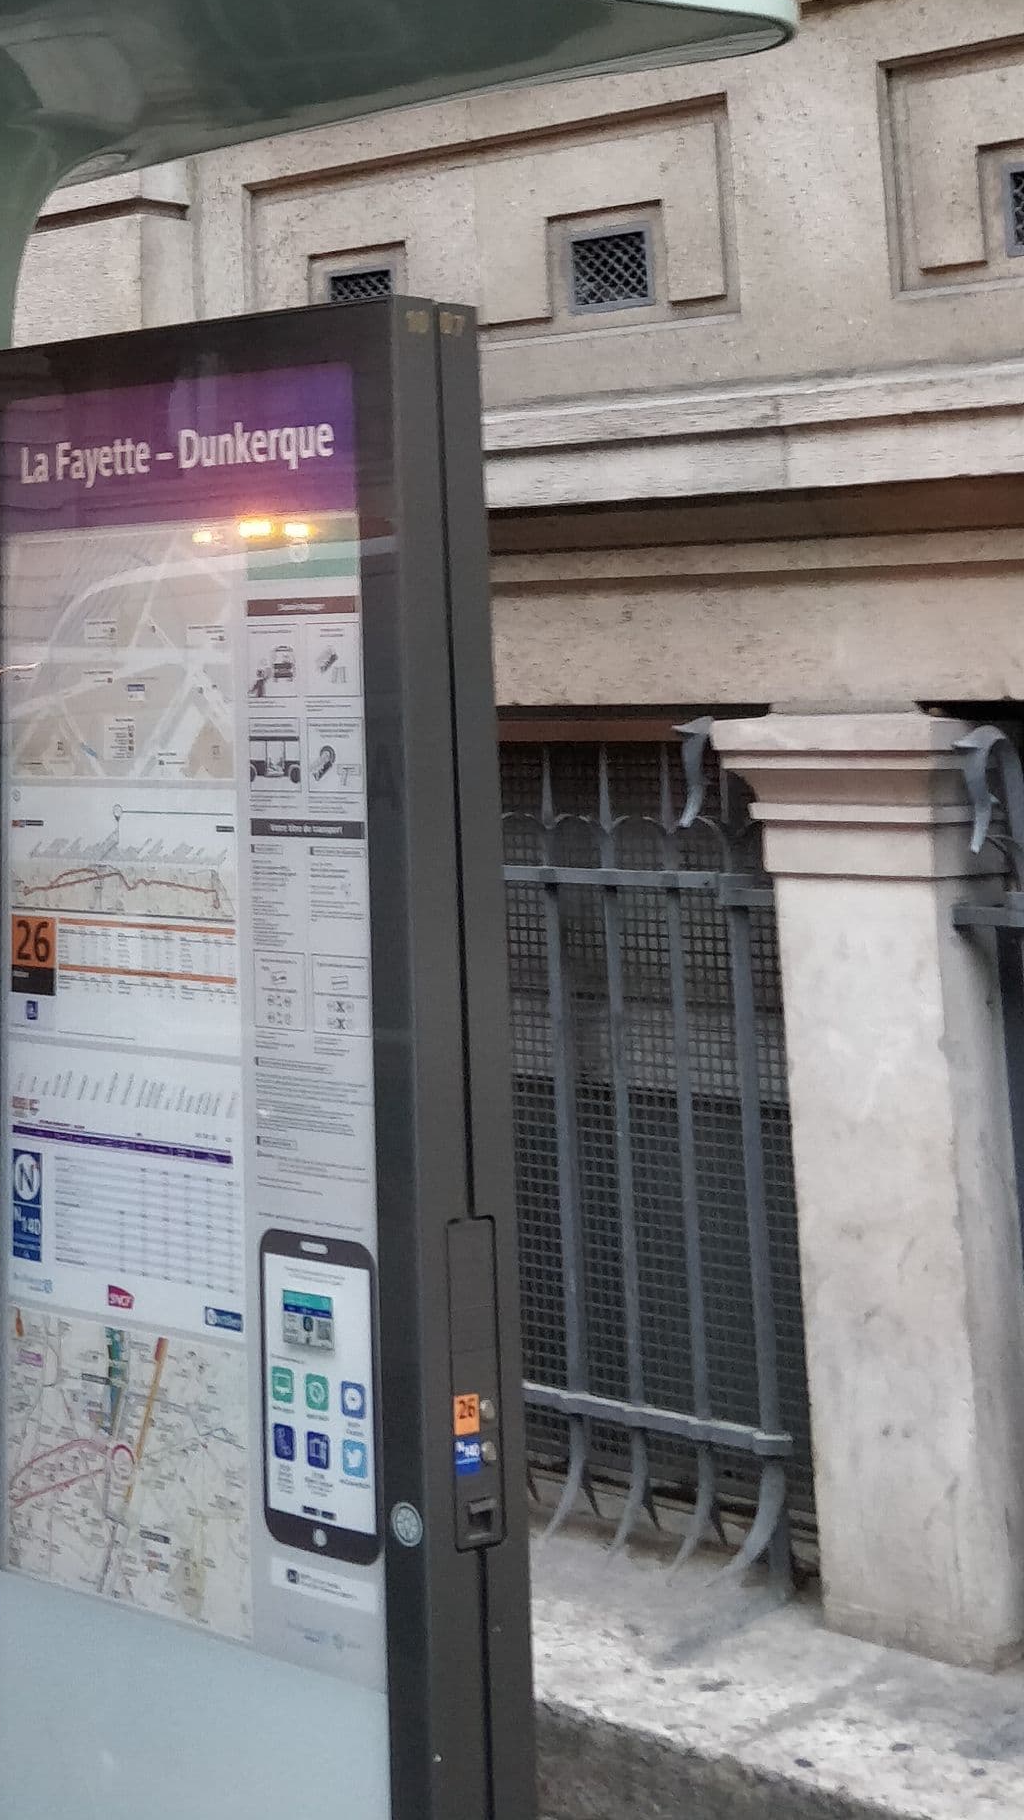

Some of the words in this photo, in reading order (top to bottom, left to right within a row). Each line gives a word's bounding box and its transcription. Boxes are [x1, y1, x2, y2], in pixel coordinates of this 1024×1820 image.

[21, 446, 49, 484] La
[56, 437, 151, 489] Fayette
[178, 421, 335, 470] Dunkerque
[16, 919, 51, 963] 26
[459, 1397, 476, 1420] 26
